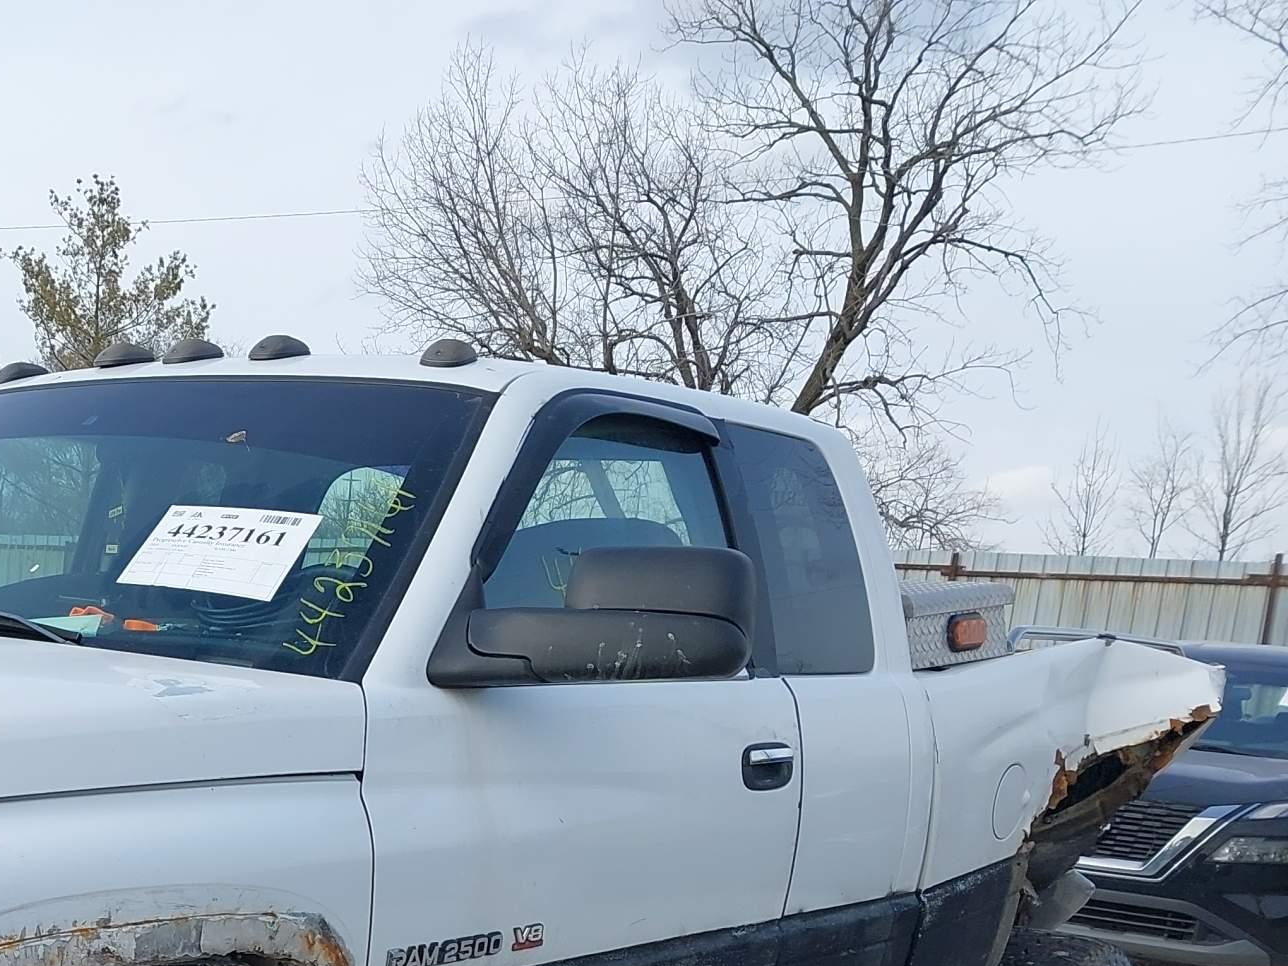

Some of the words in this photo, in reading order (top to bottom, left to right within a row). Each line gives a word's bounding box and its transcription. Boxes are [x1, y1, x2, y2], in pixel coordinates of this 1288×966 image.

[167, 523, 288, 547] 44237161
[441, 931, 504, 963] 2500
[512, 923, 544, 946] V8
